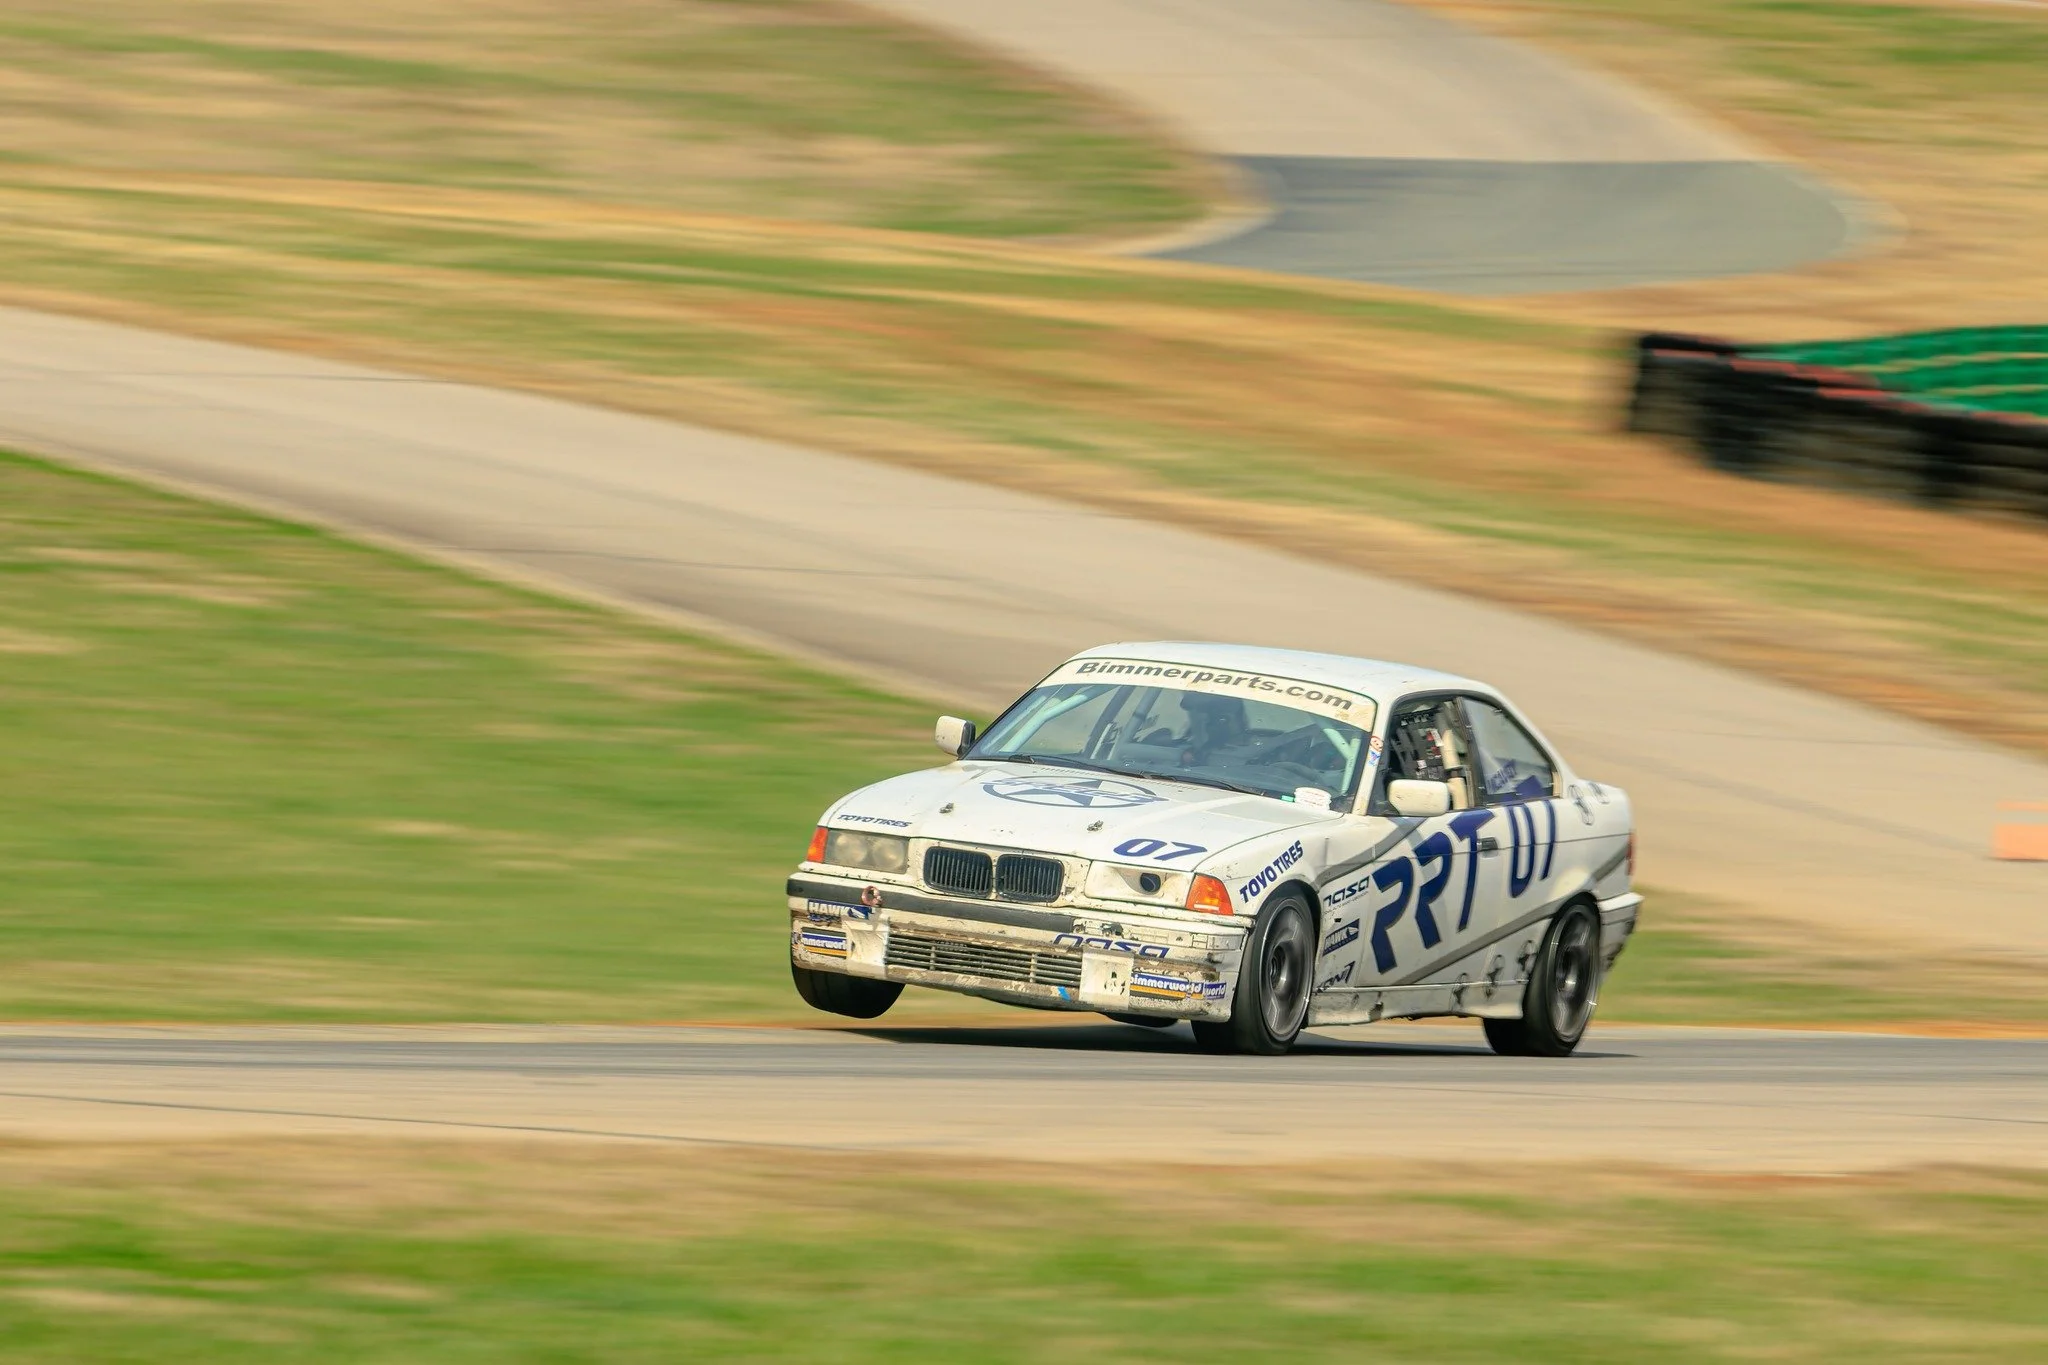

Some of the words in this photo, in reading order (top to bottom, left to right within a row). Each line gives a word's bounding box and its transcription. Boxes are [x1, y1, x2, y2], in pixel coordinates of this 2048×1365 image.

[1076, 661, 1353, 710] Bimmerparts.com
[837, 814, 874, 823] TOYO
[873, 818, 912, 828] TIRES
[1113, 838, 1208, 861] 07
[1239, 866, 1278, 903] TOYO
[1273, 840, 1304, 874] TIRES
[808, 901, 850, 918] HAWK
